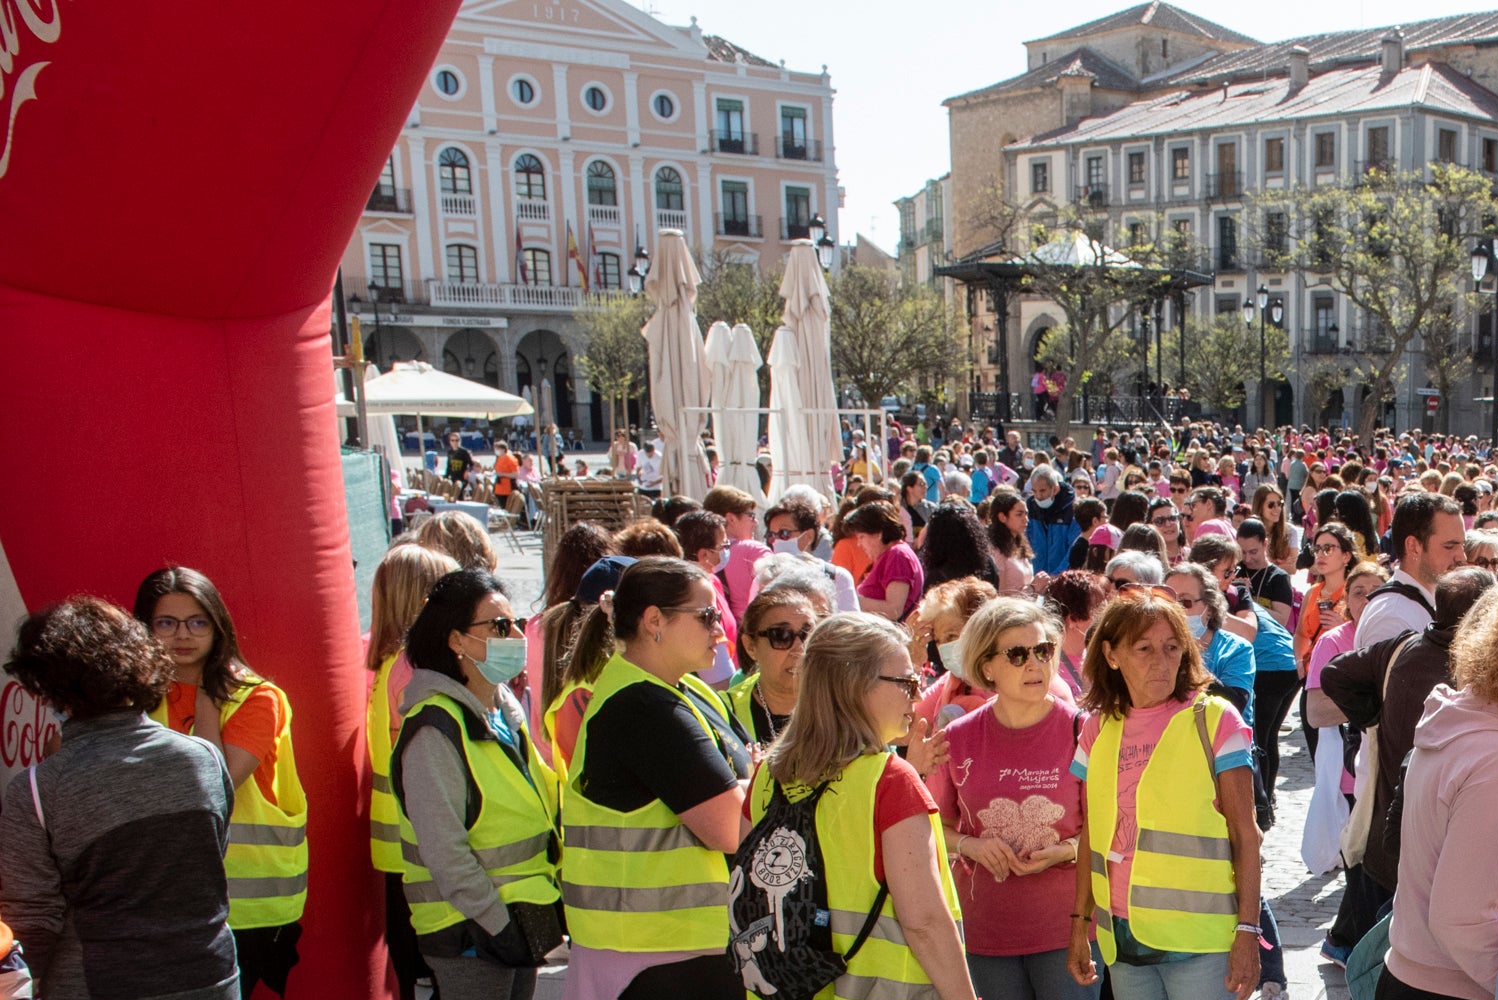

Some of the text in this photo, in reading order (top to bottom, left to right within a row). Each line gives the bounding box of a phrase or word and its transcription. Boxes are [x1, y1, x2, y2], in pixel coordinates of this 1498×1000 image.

[533, 4, 580, 23] 1917
[780, 838, 802, 879] ZRAGOZA
[758, 868, 781, 885] 2008
